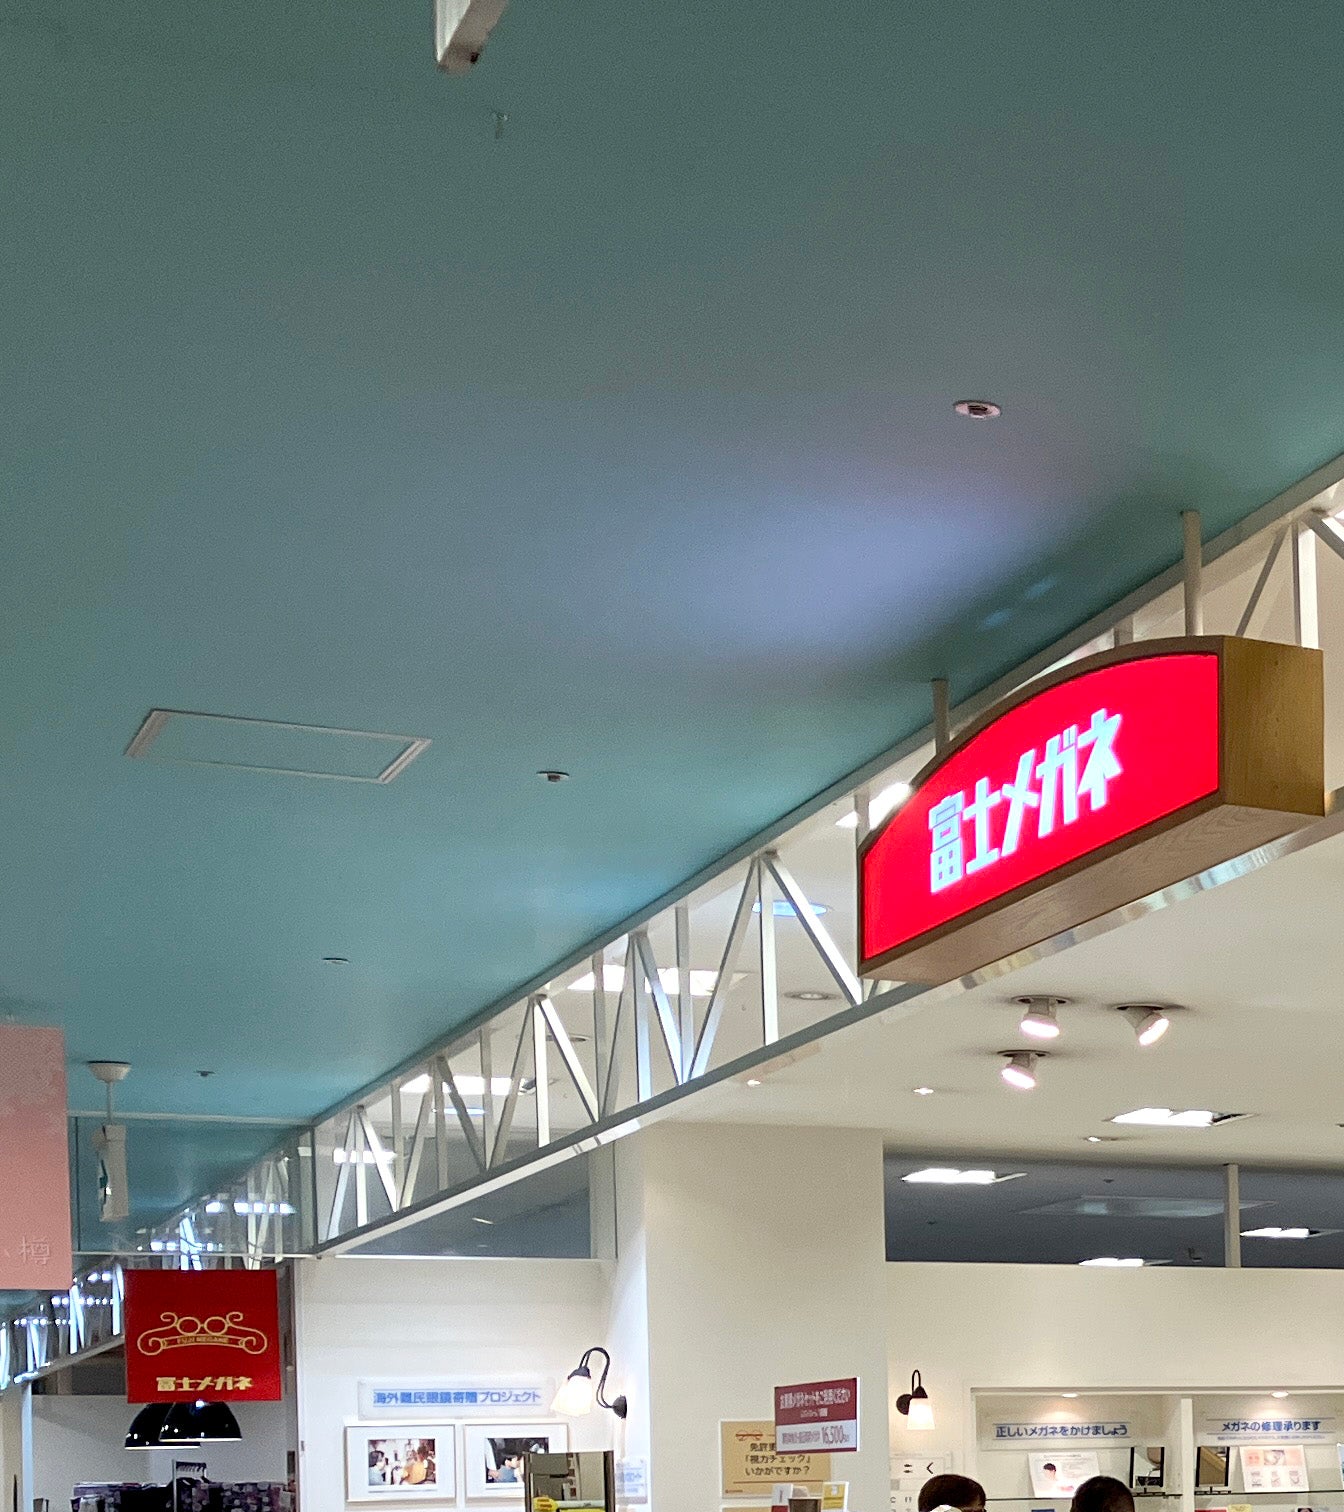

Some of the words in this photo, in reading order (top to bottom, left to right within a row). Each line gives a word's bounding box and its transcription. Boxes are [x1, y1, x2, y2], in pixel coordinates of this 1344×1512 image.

[927, 707, 1124, 894] 富士メガネ
[156, 1376, 254, 1392] 富士メガネ
[996, 1424, 1128, 1438] 正しいメガネをかけましょう
[1222, 1420, 1321, 1432] メガネの修理承ります
